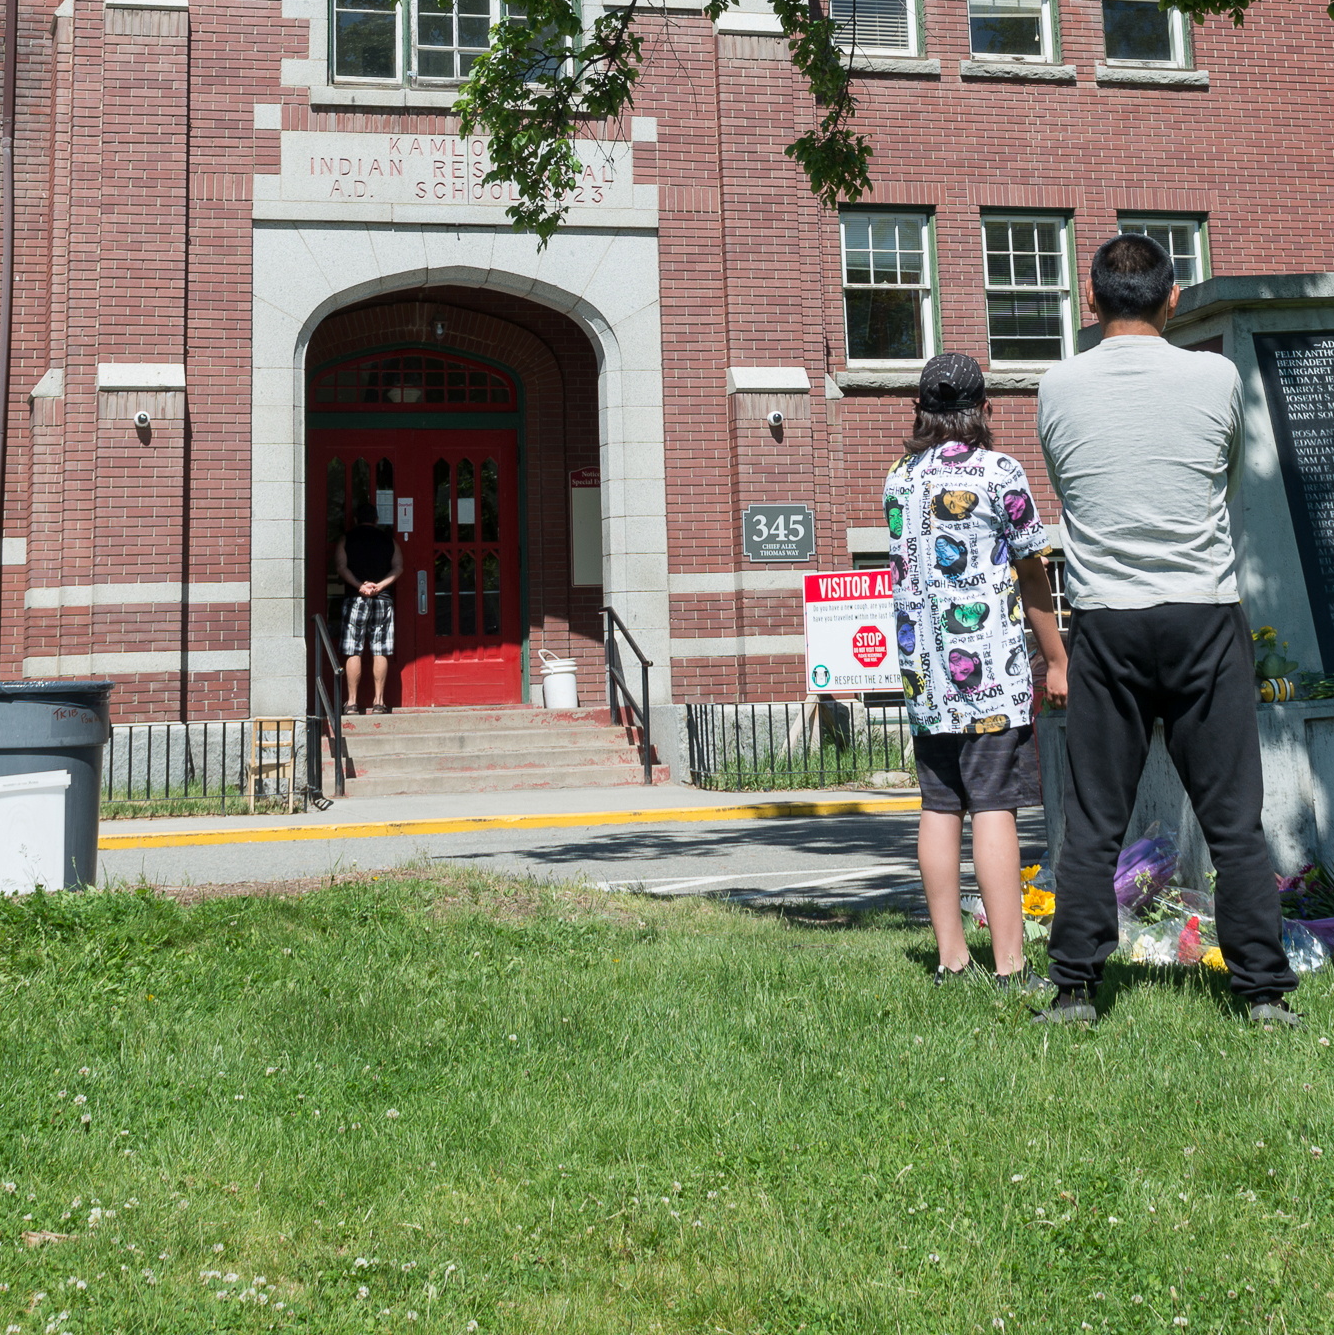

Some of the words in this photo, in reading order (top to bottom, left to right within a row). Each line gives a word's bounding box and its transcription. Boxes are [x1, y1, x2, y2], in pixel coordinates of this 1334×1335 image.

[310, 157, 404, 177] INDIAN
[329, 179, 373, 198] A.D.
[415, 181, 523, 201] SCHOOL
[1274, 350, 1302, 358] FELIX
[1278, 366, 1332, 375] MARGARET
[1279, 376, 1310, 384] HILDA
[1282, 385, 1315, 393] BARRY
[1284, 393, 1322, 402] JOSEPH
[1286, 403, 1314, 411] ANNA
[1288, 412, 1315, 420] MARY
[1291, 429, 1317, 437] ROSA
[1297, 456, 1318, 464] SAM
[955, 467, 984, 477] BOYZ
[1298, 465, 1322, 473] TOM
[753, 515, 805, 541] 345
[921, 511, 931, 536] BOYZ
[907, 537, 917, 563] BOYZ
[819, 576, 870, 598] VISITOR
[856, 633, 882, 646] STOP
[934, 627, 944, 652] BOYZ
[835, 675, 861, 684] RESPECT
[865, 675, 876, 684] THE
[879, 675, 882, 683] 2
